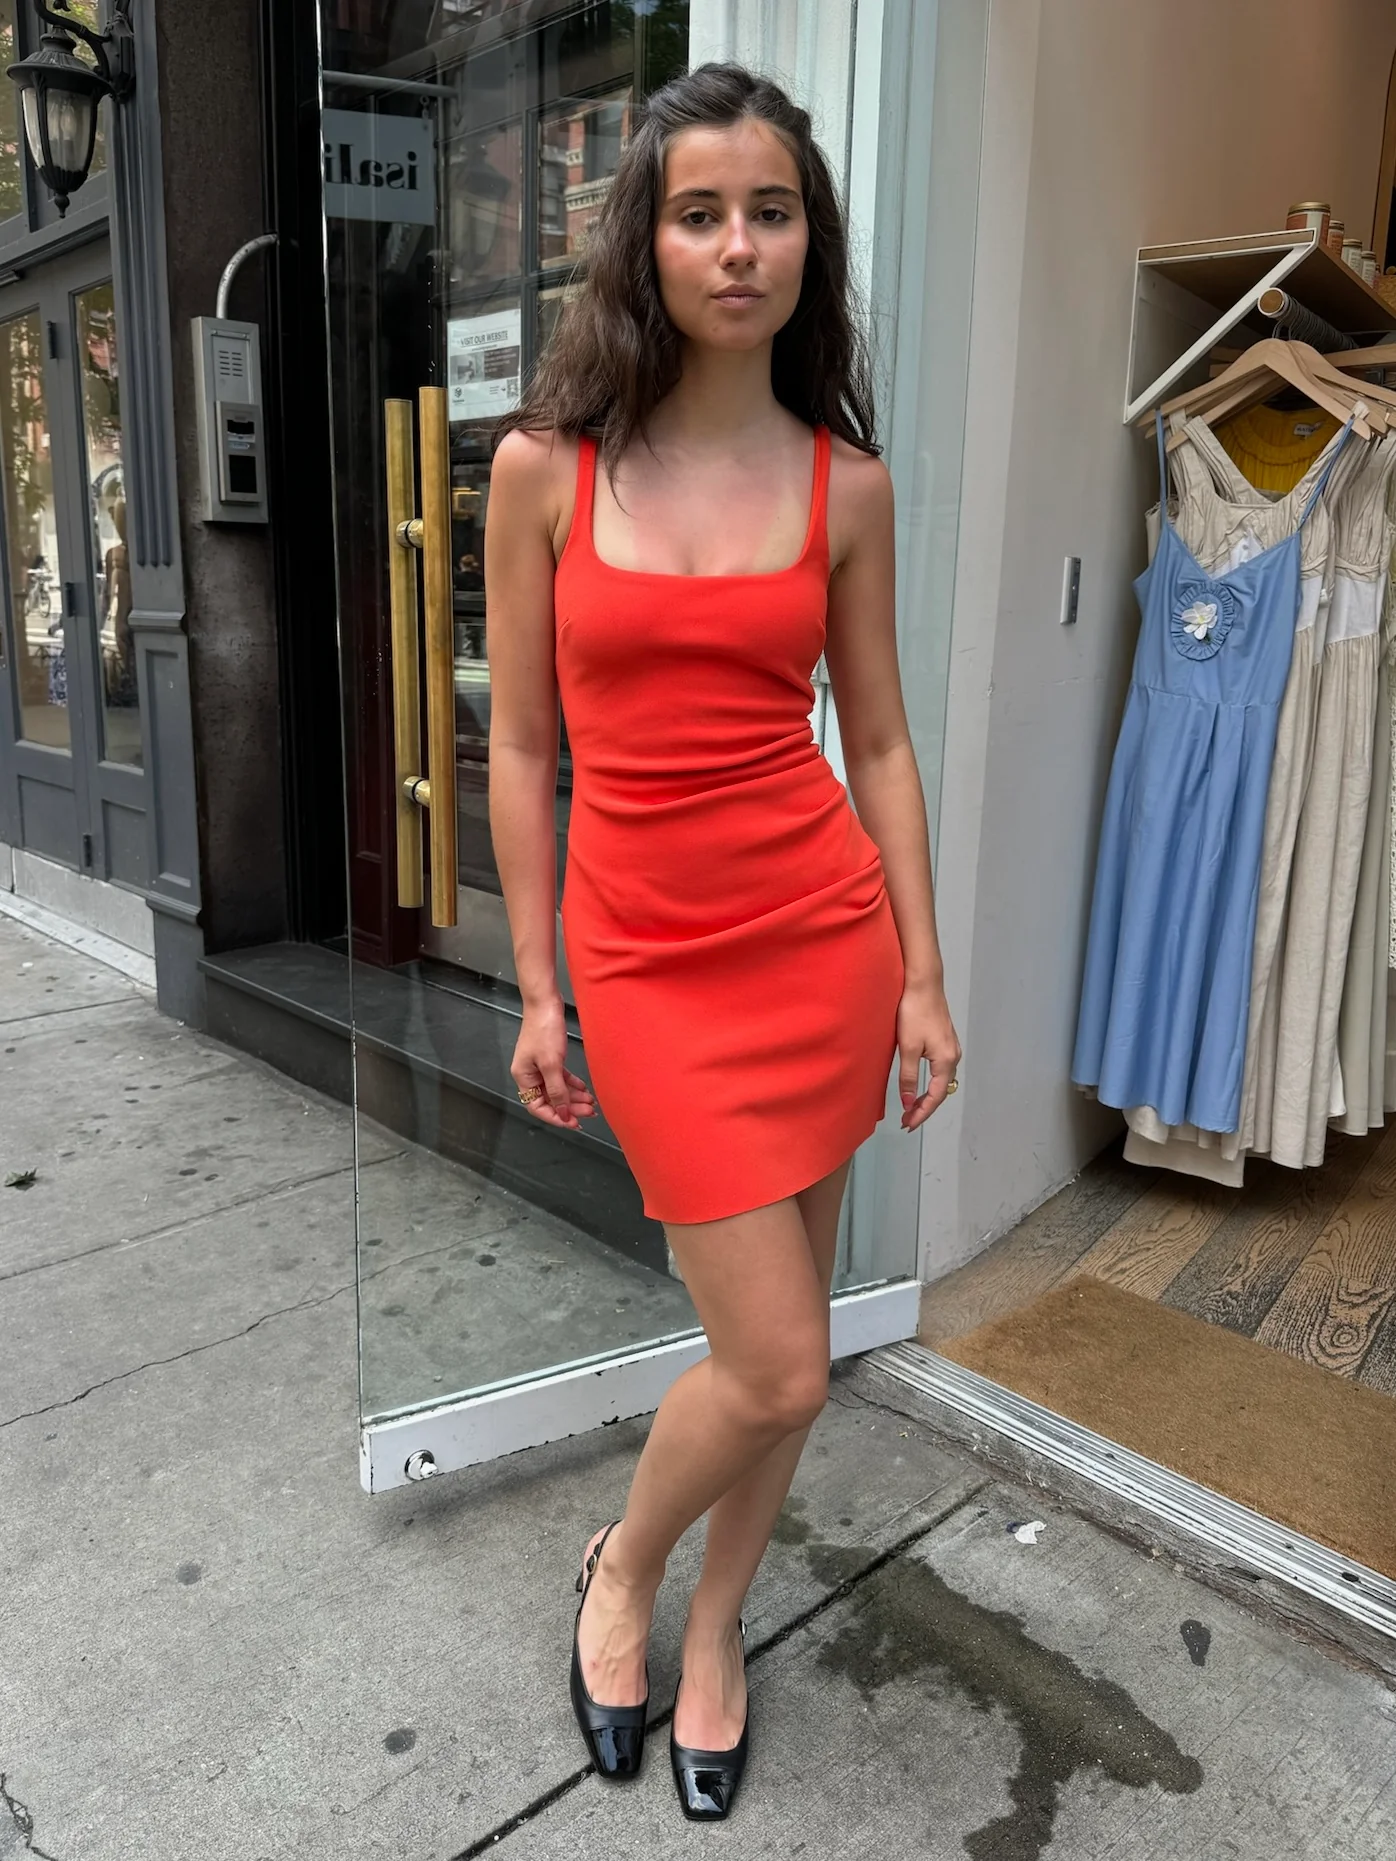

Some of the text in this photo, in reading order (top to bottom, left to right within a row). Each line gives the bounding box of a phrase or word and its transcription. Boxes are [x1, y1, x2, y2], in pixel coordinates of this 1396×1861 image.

[461, 330, 508, 346] VISIT OUR WEBSITE
